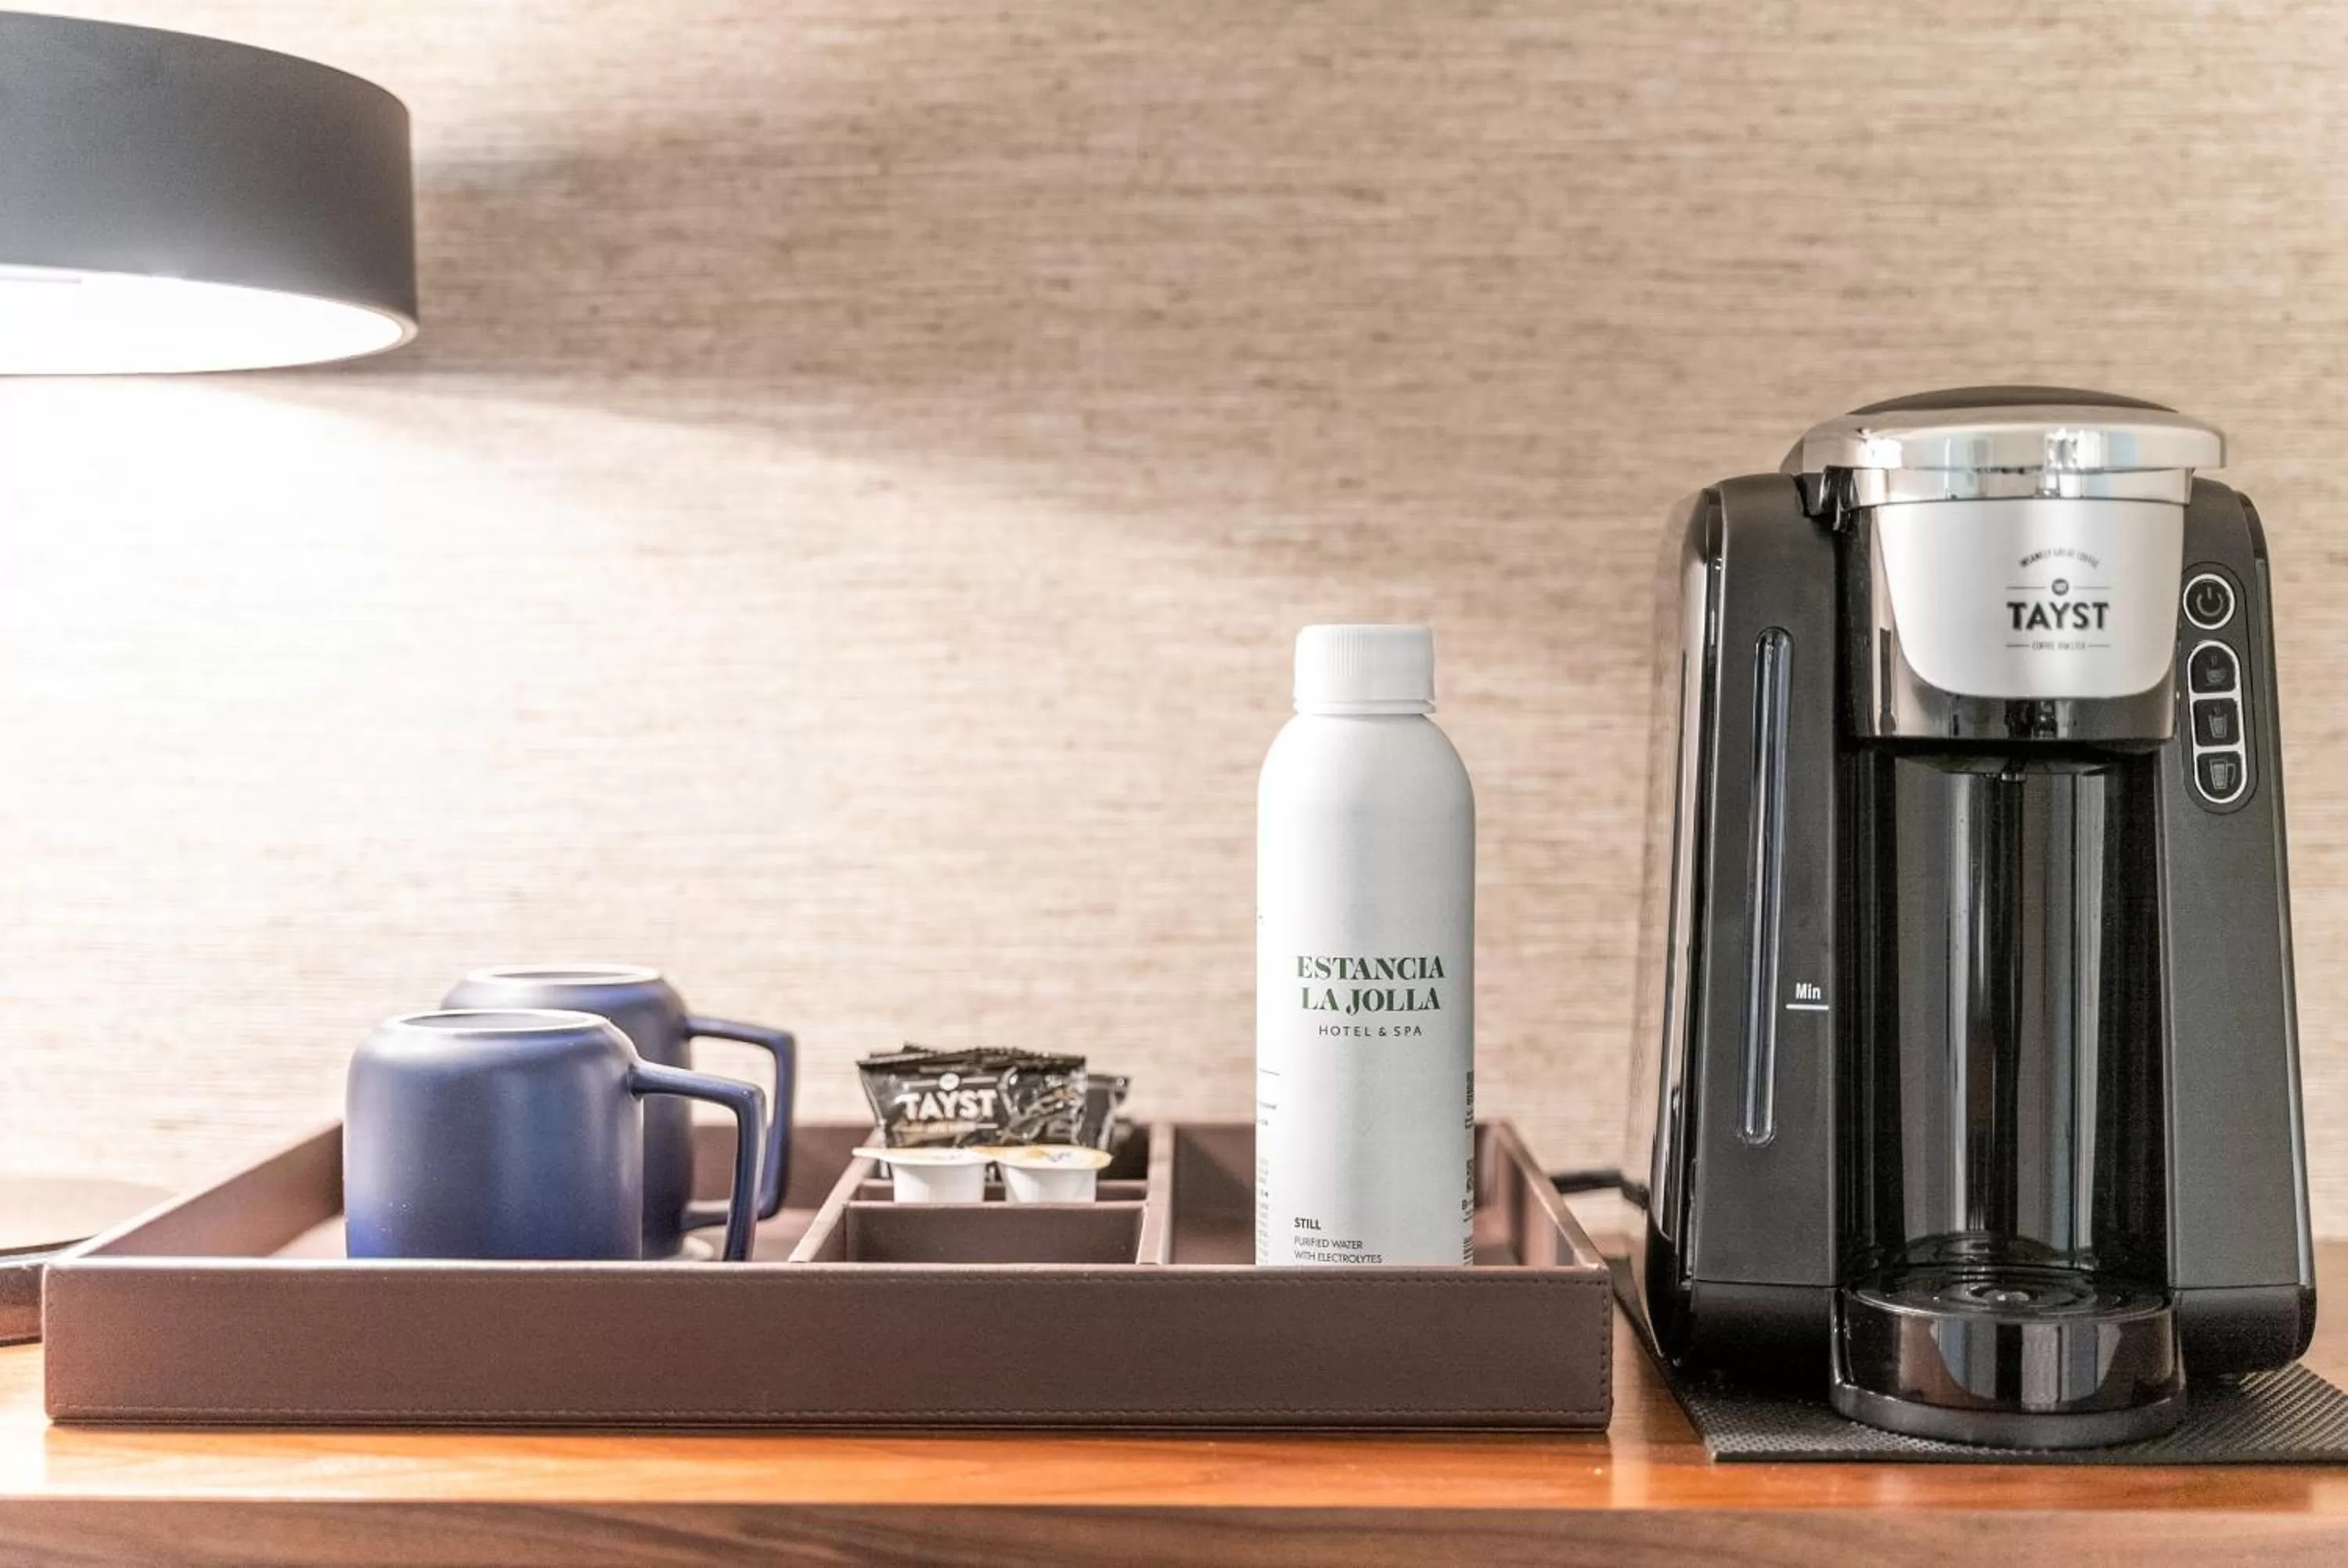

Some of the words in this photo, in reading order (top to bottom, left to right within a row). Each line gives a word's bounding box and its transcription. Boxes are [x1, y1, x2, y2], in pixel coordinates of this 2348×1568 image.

[2006, 601, 2110, 631] TAYST
[1295, 955, 1446, 980] ESTANCIA
[1795, 982, 1821, 1000] Min
[1301, 987, 1340, 1011] LA
[1345, 987, 1441, 1016] JOLLA
[1318, 1025, 1372, 1037] HOTEL
[1378, 1026, 1388, 1037] &
[1393, 1026, 1423, 1037] SPA
[894, 1089, 998, 1120] TAYST
[1294, 1217, 1322, 1231] STILL
[1294, 1235, 1330, 1249] PURIFIED
[1331, 1239, 1363, 1250] WATER
[1294, 1250, 1316, 1261] WITH
[1317, 1253, 1383, 1264] ELECTROLYTES
